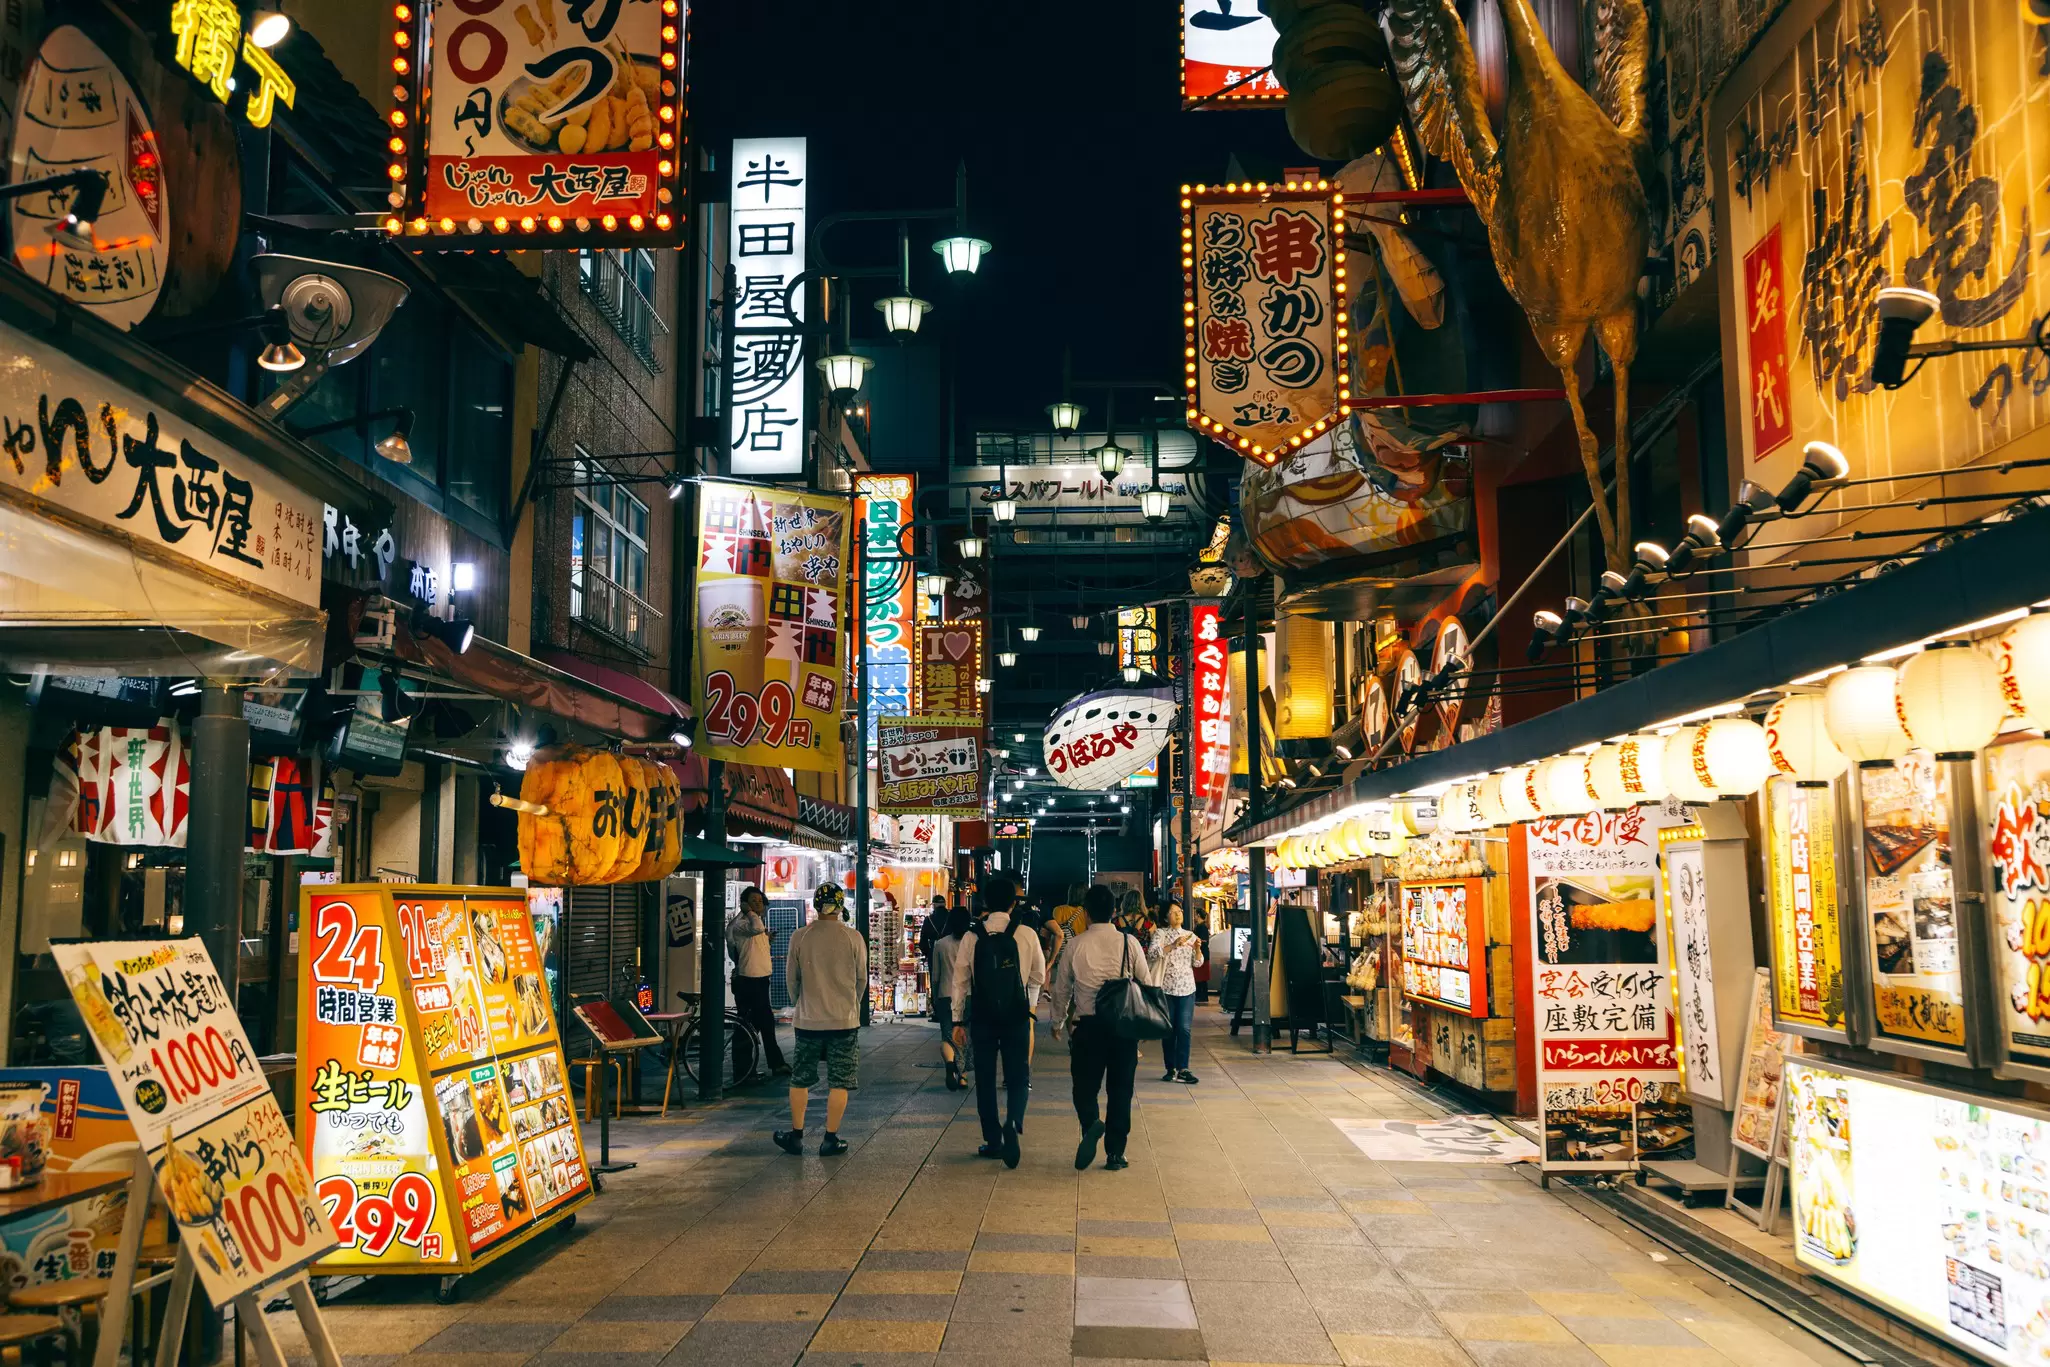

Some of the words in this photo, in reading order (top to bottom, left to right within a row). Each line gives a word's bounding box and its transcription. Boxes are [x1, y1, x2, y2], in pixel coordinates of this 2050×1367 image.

[443, 162, 514, 188] じゃん
[467, 185, 527, 208] じゃん
[526, 162, 644, 206] 大西屋
[731, 153, 805, 452] 半田屋酒店
[1201, 213, 1255, 392] お好み焼き
[1250, 208, 1324, 388] 串かつ
[116, 411, 265, 571] 大西屋
[1008, 478, 1114, 501] スパワールド
[270, 501, 283, 567] 日本酒
[773, 507, 819, 533] 新世界
[304, 516, 316, 582] 生ビール
[780, 533, 827, 556] おやじの
[805, 688, 831, 709] 無休
[808, 675, 833, 695] 年中
[704, 670, 812, 748] 299円
[888, 747, 949, 778] ビリーズ
[920, 765, 949, 775] Shop
[1049, 722, 1139, 774] づぼらや
[1619, 740, 1647, 793] 鉄板料理
[127, 736, 146, 840] 新世界
[879, 772, 979, 804] 大阪みやげ
[1789, 800, 1818, 991] 24時間営業
[315, 902, 384, 992] 24
[398, 904, 437, 979] 24
[316, 986, 398, 1025] 時間営業
[1537, 969, 1665, 1001] 宴会受付中
[365, 1026, 400, 1046] 年中
[423, 1012, 454, 1056] 生ビール
[1543, 1002, 1657, 1034] 座敷完備
[362, 1044, 397, 1066] 無休
[1545, 1042, 1682, 1070] いらっしゃいま
[310, 1059, 412, 1113] 生ビール
[328, 1110, 404, 1135] いつでも
[196, 1136, 266, 1196] 串かつ
